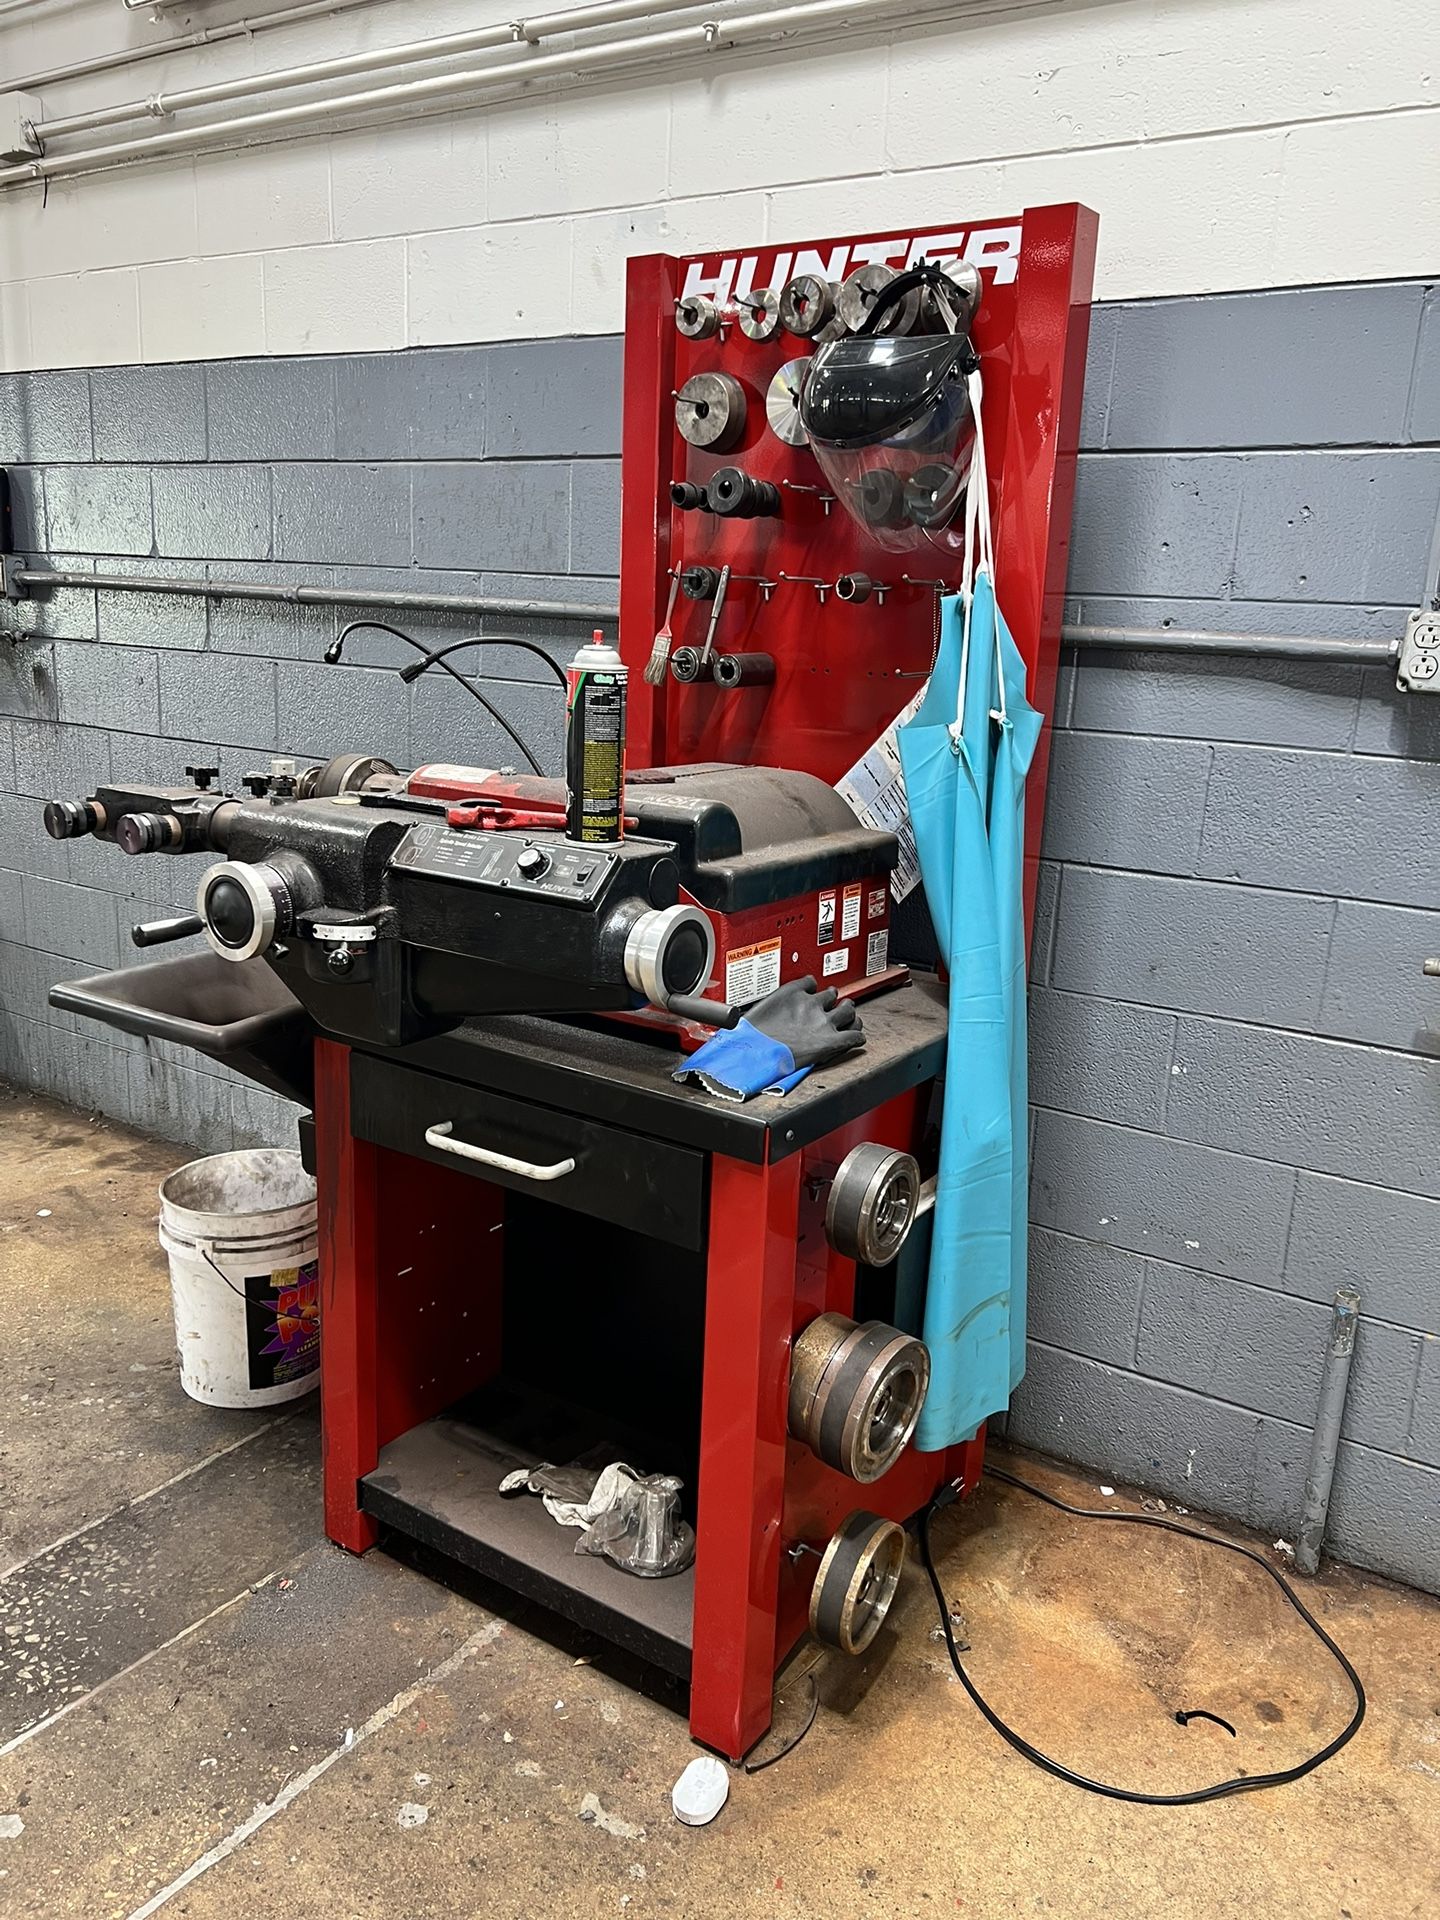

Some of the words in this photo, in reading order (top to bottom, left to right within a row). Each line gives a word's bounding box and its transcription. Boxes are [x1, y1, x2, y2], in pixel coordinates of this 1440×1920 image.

[680, 226, 1022, 310] HUNTER
[540, 882, 584, 896] HUNTER
[727, 947, 753, 961] WARNING
